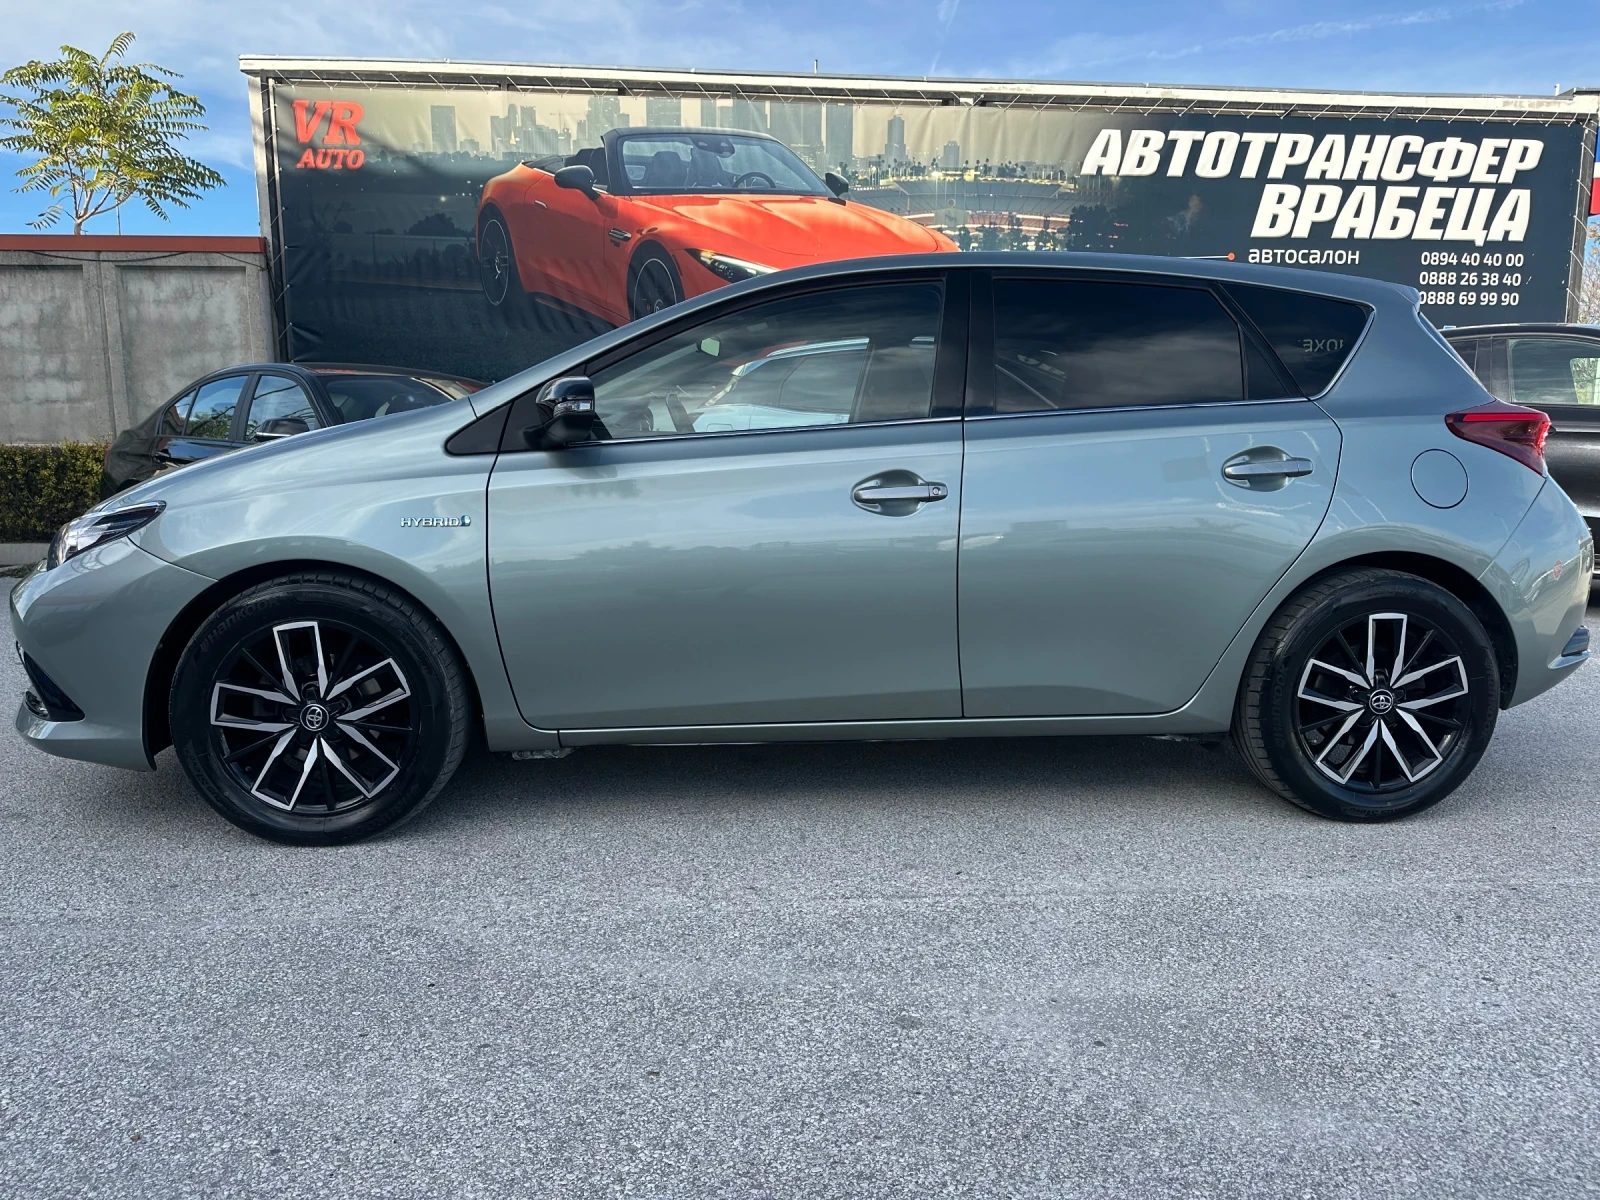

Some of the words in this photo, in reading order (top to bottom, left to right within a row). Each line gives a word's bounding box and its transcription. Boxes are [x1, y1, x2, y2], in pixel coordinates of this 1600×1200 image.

[292, 99, 364, 145] VR
[296, 148, 365, 170] AUTO
[1081, 128, 1544, 183] АВТОТРАНСФЕР
[1250, 183, 1531, 247] ВРАБЕЦА
[1248, 247, 1360, 265] автосалон
[1420, 251, 1458, 266] 0894
[1460, 252, 1480, 266] 40
[1483, 253, 1502, 267] 40
[1505, 253, 1524, 267] 00
[1419, 271, 1457, 286] 0888
[1460, 272, 1478, 286] 26
[1481, 272, 1499, 286] 38
[1502, 273, 1522, 287] 40
[1419, 291, 1455, 305] 0888
[1458, 291, 1477, 306] 69
[1480, 292, 1498, 306] 99
[1501, 292, 1520, 306] 90
[400, 516, 459, 528] HYBRID
